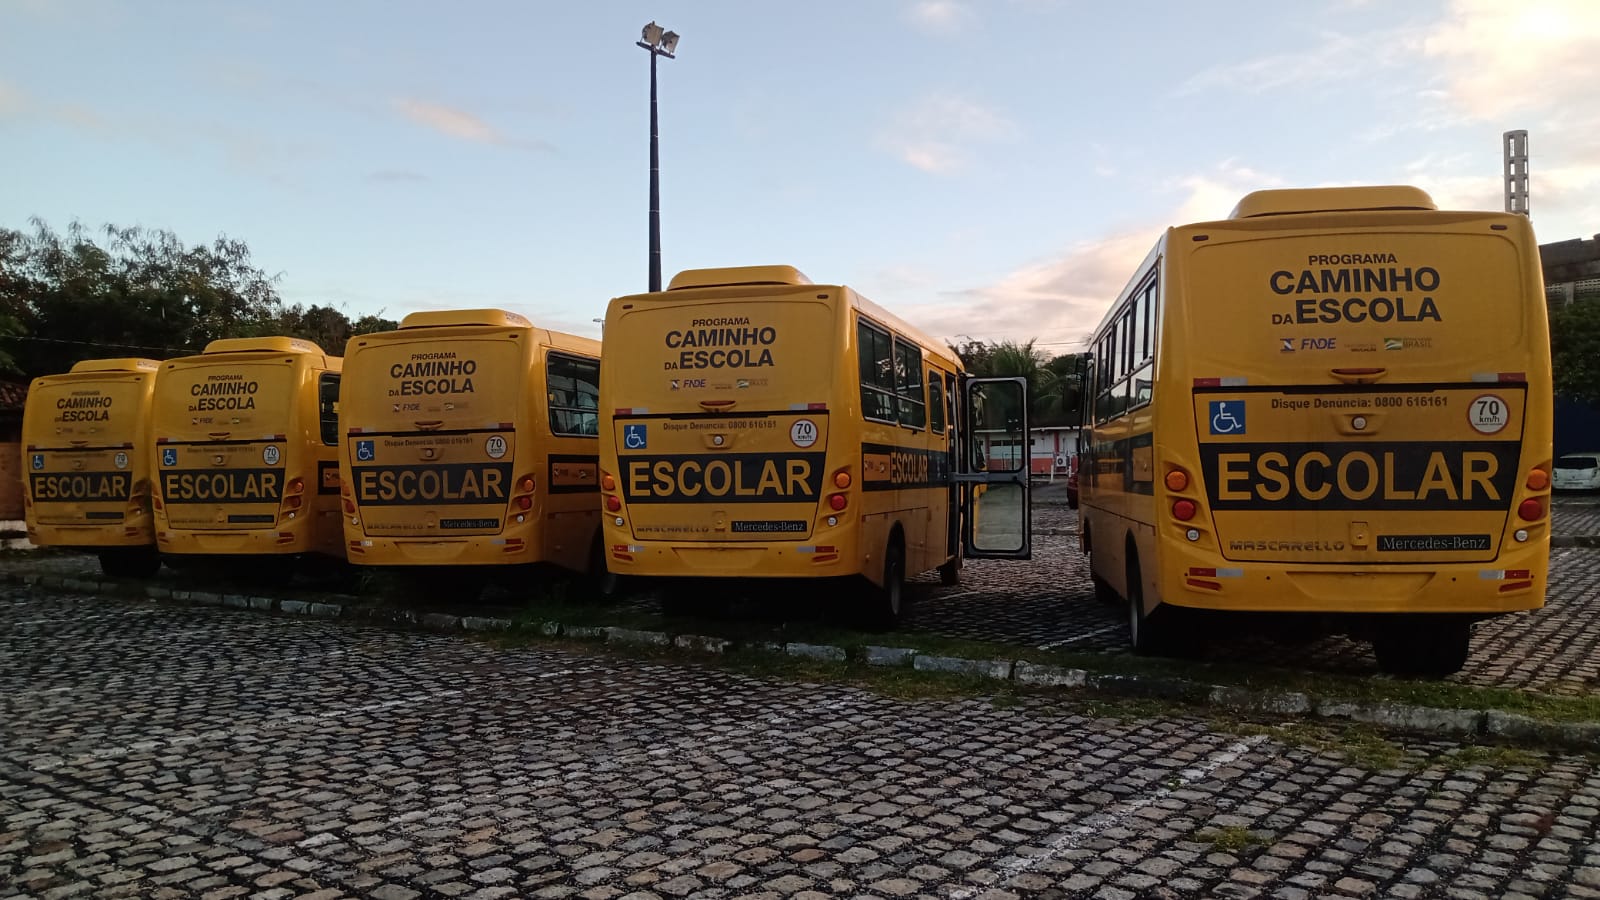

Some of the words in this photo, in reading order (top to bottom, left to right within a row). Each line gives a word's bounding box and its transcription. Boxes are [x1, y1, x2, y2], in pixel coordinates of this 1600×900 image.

[1308, 253, 1398, 266] PROGRAMA
[1269, 267, 1440, 295] CAMINHO
[1272, 313, 1294, 325] DA
[1295, 296, 1442, 325] ESCOLA
[692, 317, 750, 327] PROGRAMA
[665, 326, 776, 348] CAMINHO
[1301, 337, 1337, 350] FNDE
[411, 352, 456, 361] PROGRAMA
[664, 361, 678, 370] DA
[679, 349, 775, 370] ESCOLA
[390, 360, 476, 378] CAMINHO
[191, 381, 258, 396] CAMINHO
[400, 378, 474, 396] ESCOLA
[683, 379, 706, 389] FNDE
[56, 396, 112, 409] CAMINHO
[198, 396, 255, 411] ESCOLA
[1271, 399, 1310, 411] Disque
[1375, 396, 1402, 408] 0800
[1406, 396, 1448, 408] 616161
[1477, 400, 1499, 416] 70
[62, 410, 109, 422] ESCOLA
[1479, 415, 1500, 423] km/h
[796, 423, 811, 434] 70
[489, 438, 502, 449] 70
[267, 448, 277, 457] 70
[890, 452, 928, 484] ESCOLAR
[628, 459, 813, 497] ESCOLAR
[1217, 451, 1500, 501] ESCOLAR
[34, 476, 126, 498] ESCOLAR
[166, 473, 278, 499] ESCOLAR
[360, 468, 504, 500] ESCOLAR
[735, 521, 804, 532] Mercedes-Benz
[1383, 536, 1487, 549] Mercedes-Benz
